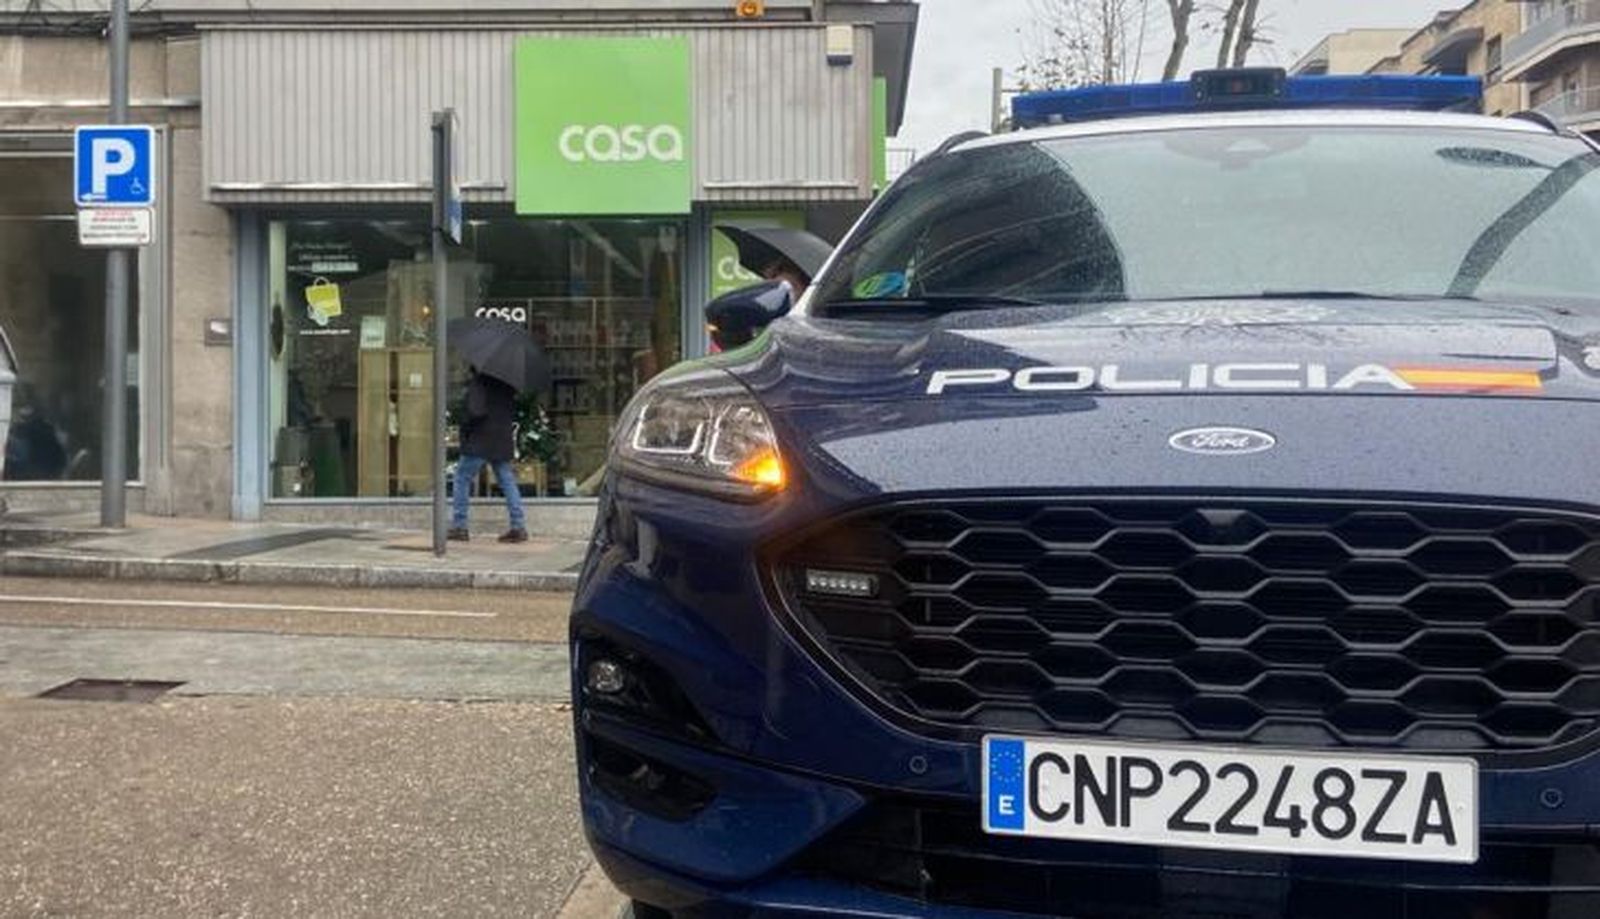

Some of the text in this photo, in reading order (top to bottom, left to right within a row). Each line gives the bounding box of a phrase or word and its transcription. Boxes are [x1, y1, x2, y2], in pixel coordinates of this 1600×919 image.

[560, 124, 682, 160] casa
[92, 138, 135, 195] P
[926, 362, 1415, 395] POLICIA
[1191, 432, 1249, 448] Ford
[998, 795, 1015, 815] E
[1028, 751, 1458, 847] CNP2248ZA
